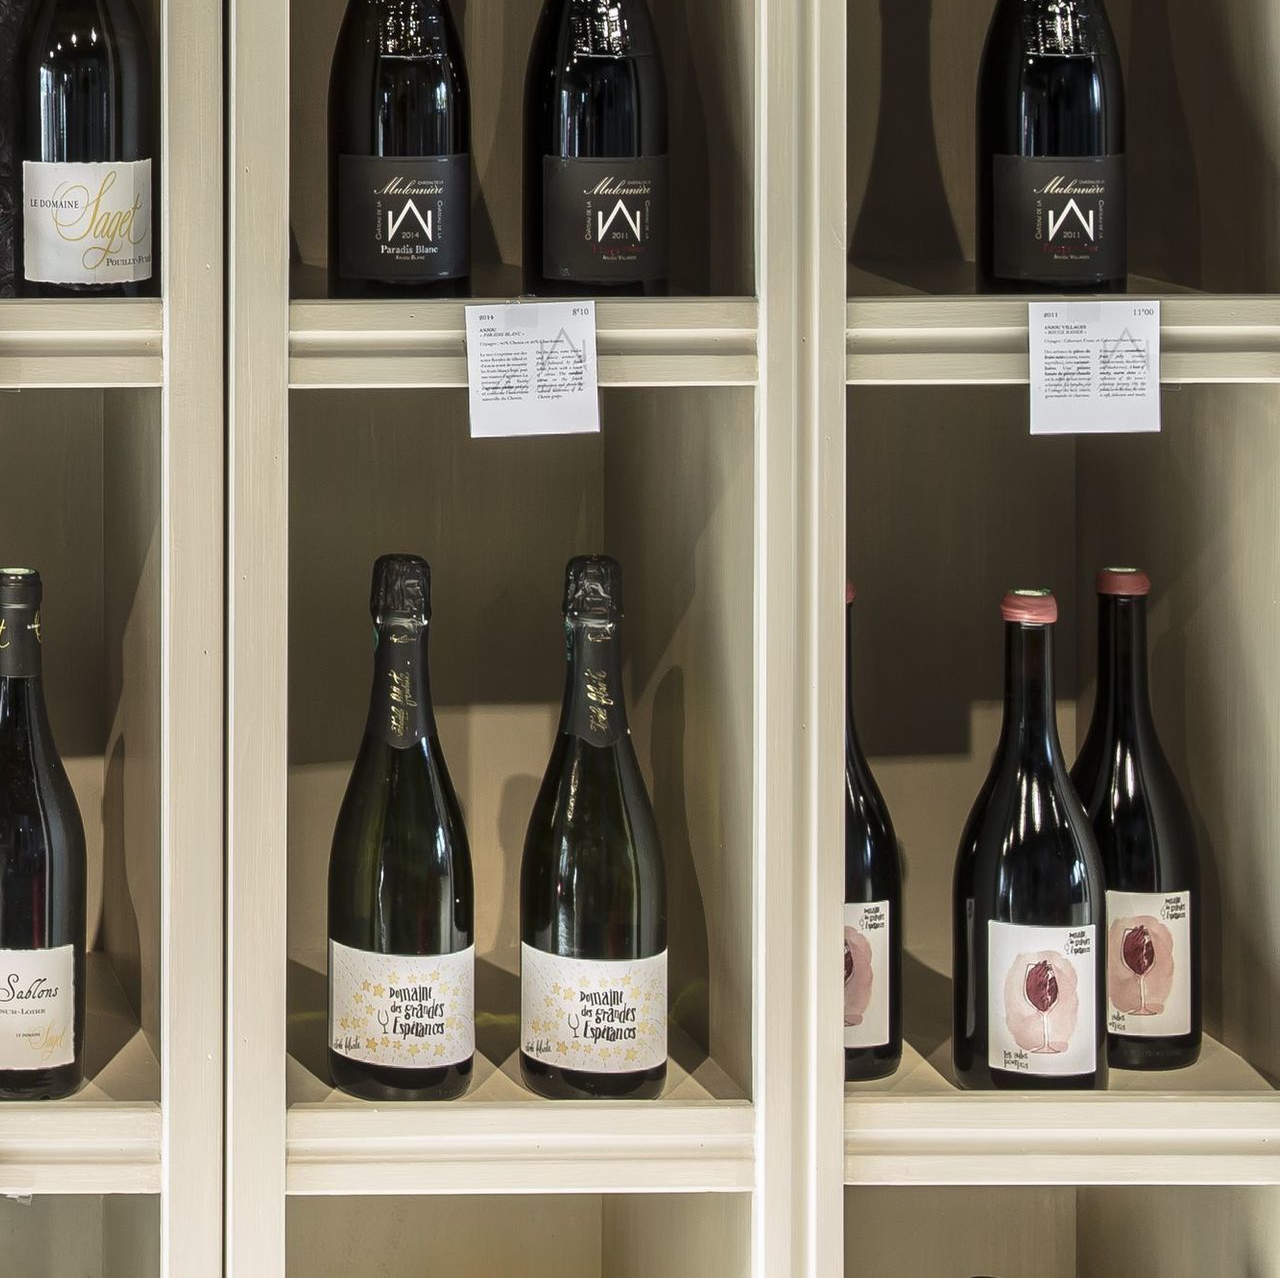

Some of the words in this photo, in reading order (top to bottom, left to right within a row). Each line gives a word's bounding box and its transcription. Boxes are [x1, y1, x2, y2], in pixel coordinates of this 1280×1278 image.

[30, 198, 38, 208] LE
[39, 198, 80, 209] DOMAINE
[54, 170, 147, 270] Saget
[380, 244, 413, 255] Paradis
[415, 244, 439, 255] Blanc
[389, 985, 432, 1002] Domaine
[579, 988, 623, 1006] Domaine
[390, 1002, 402, 1013] des
[404, 998, 445, 1020] grandes
[581, 1006, 593, 1018] des
[594, 1003, 637, 1024] grandes
